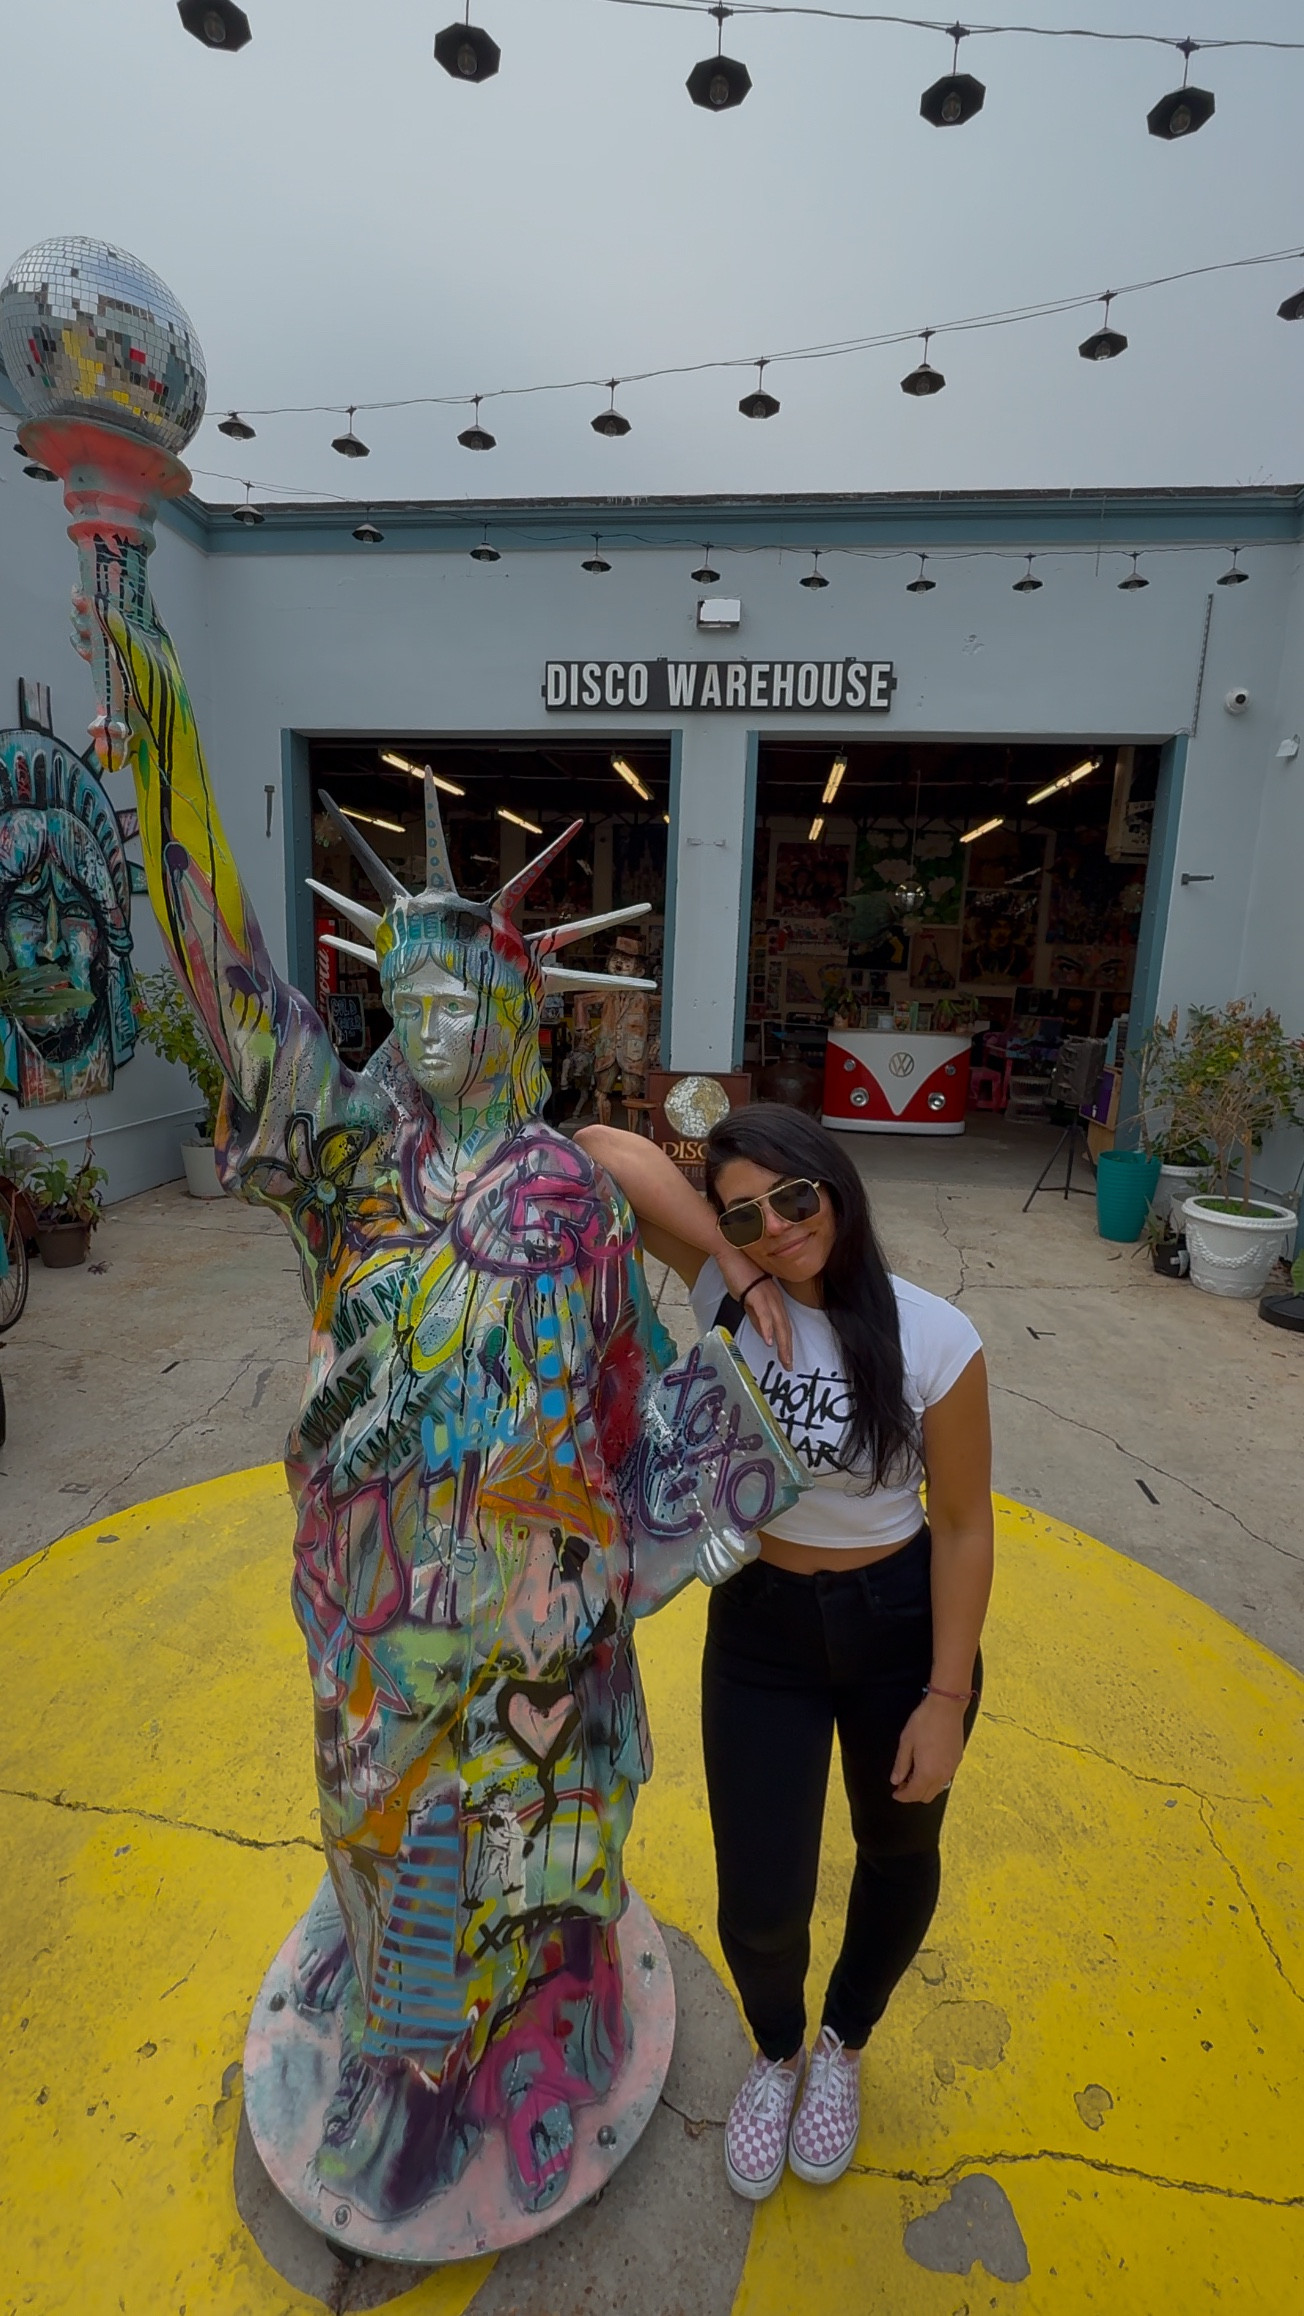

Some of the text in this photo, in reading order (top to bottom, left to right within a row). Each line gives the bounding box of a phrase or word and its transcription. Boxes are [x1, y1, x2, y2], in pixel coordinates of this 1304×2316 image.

[547, 662, 891, 708] DISCO WAREHOUSE
[889, 1052, 915, 1077] VW
[662, 1140, 709, 1159] DISC
[299, 1356, 377, 1448] WHAT
[775, 1413, 844, 1470] TAR
